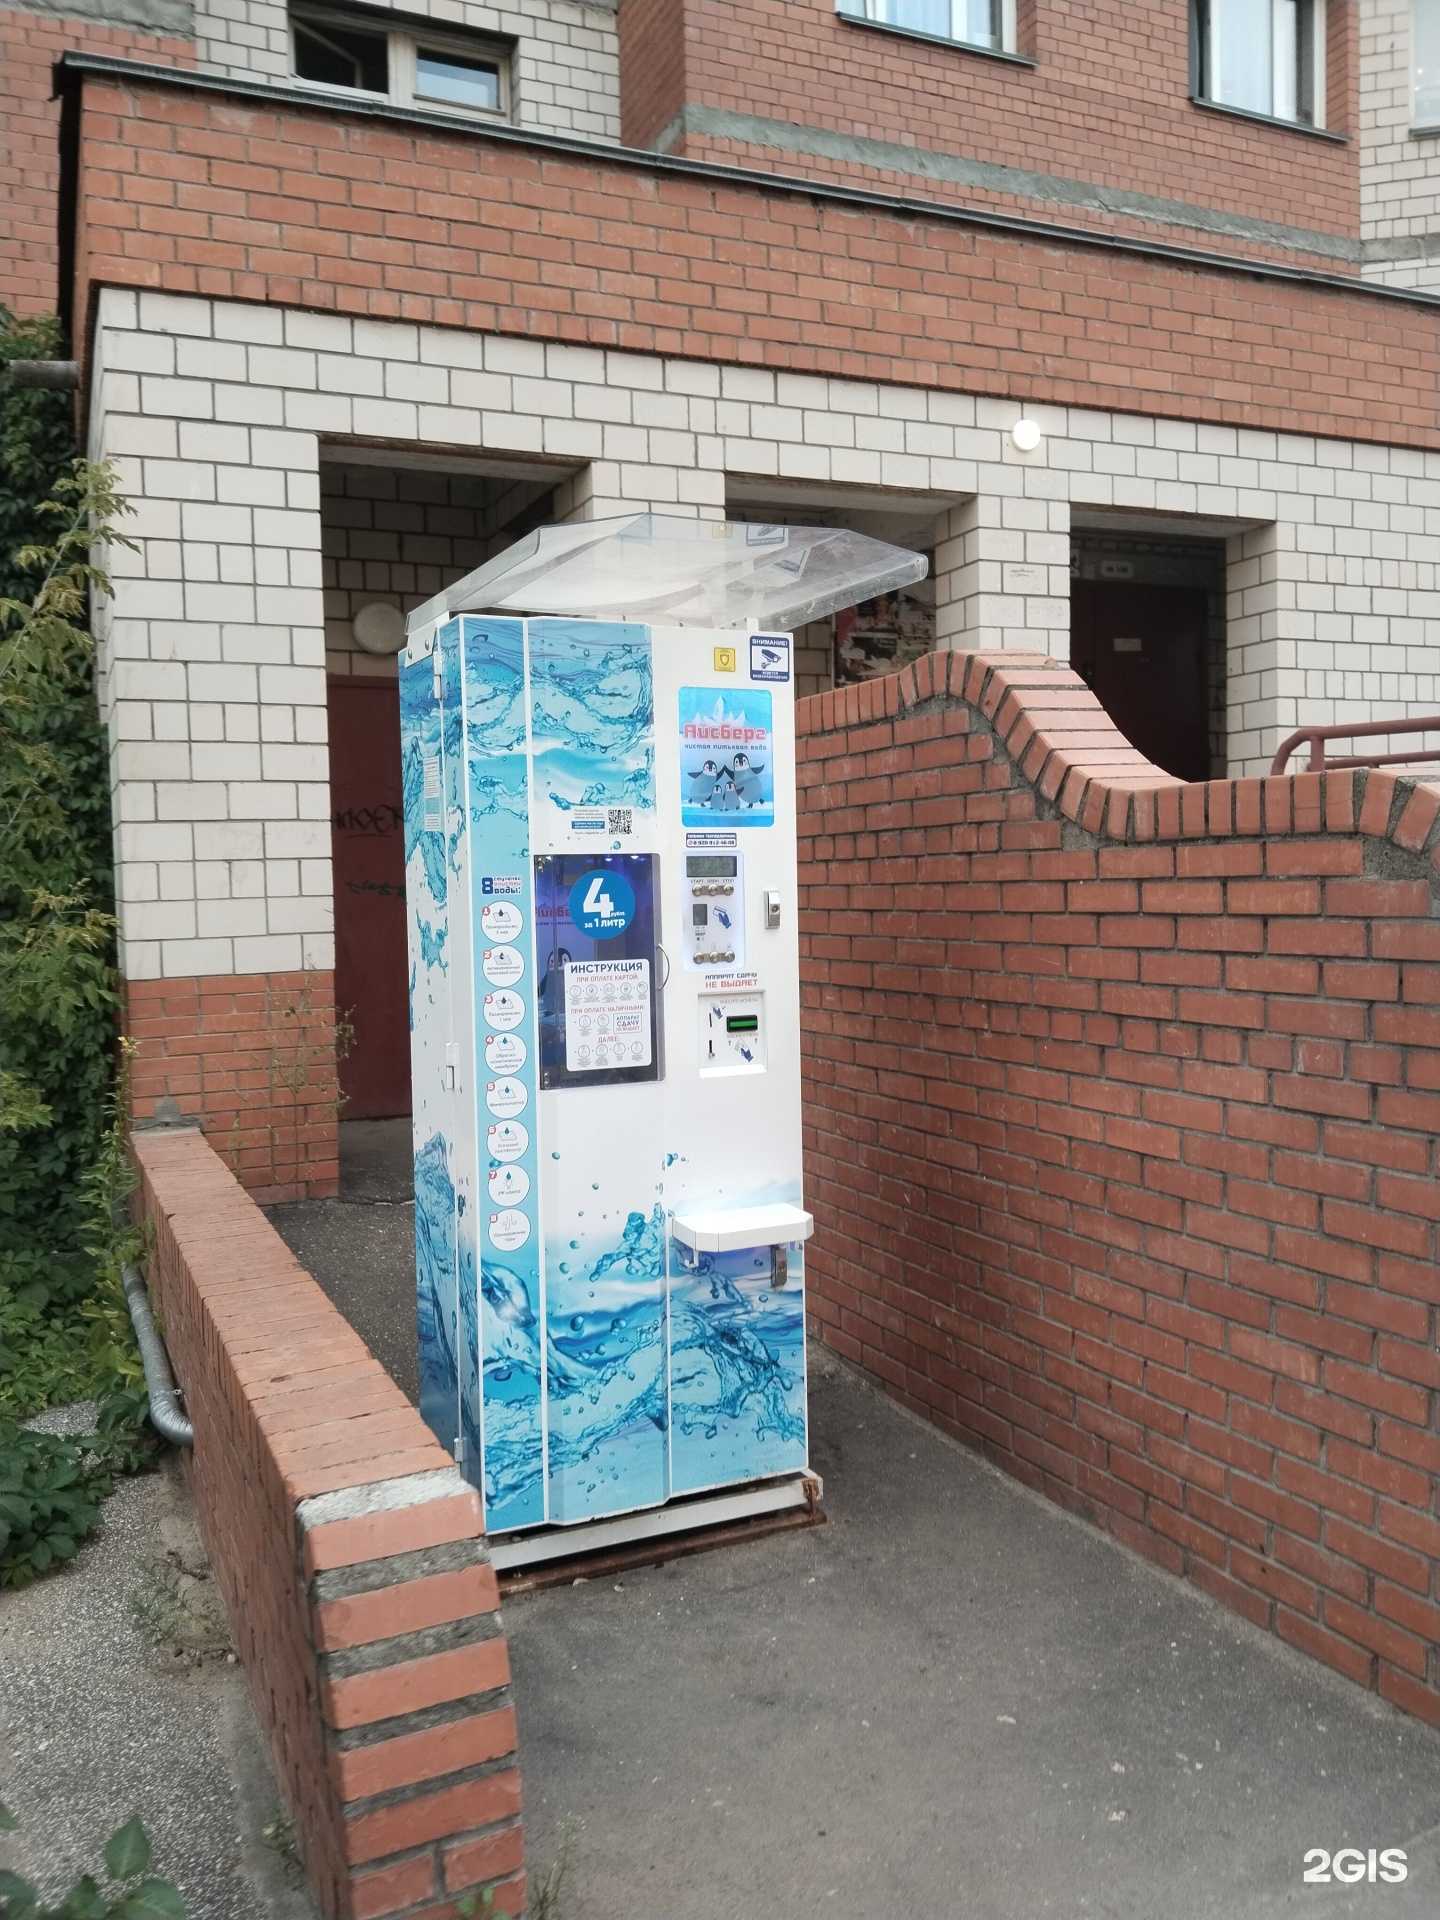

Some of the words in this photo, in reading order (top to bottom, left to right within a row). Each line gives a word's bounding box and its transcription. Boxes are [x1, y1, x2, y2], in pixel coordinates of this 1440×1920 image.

[752, 638, 788, 646] ВНИМАНИЕ!
[582, 877, 615, 919] 4
[593, 917, 600, 928] 1
[600, 917, 626, 929] литр
[570, 961, 643, 974] ИНСТРУКЦИЯ
